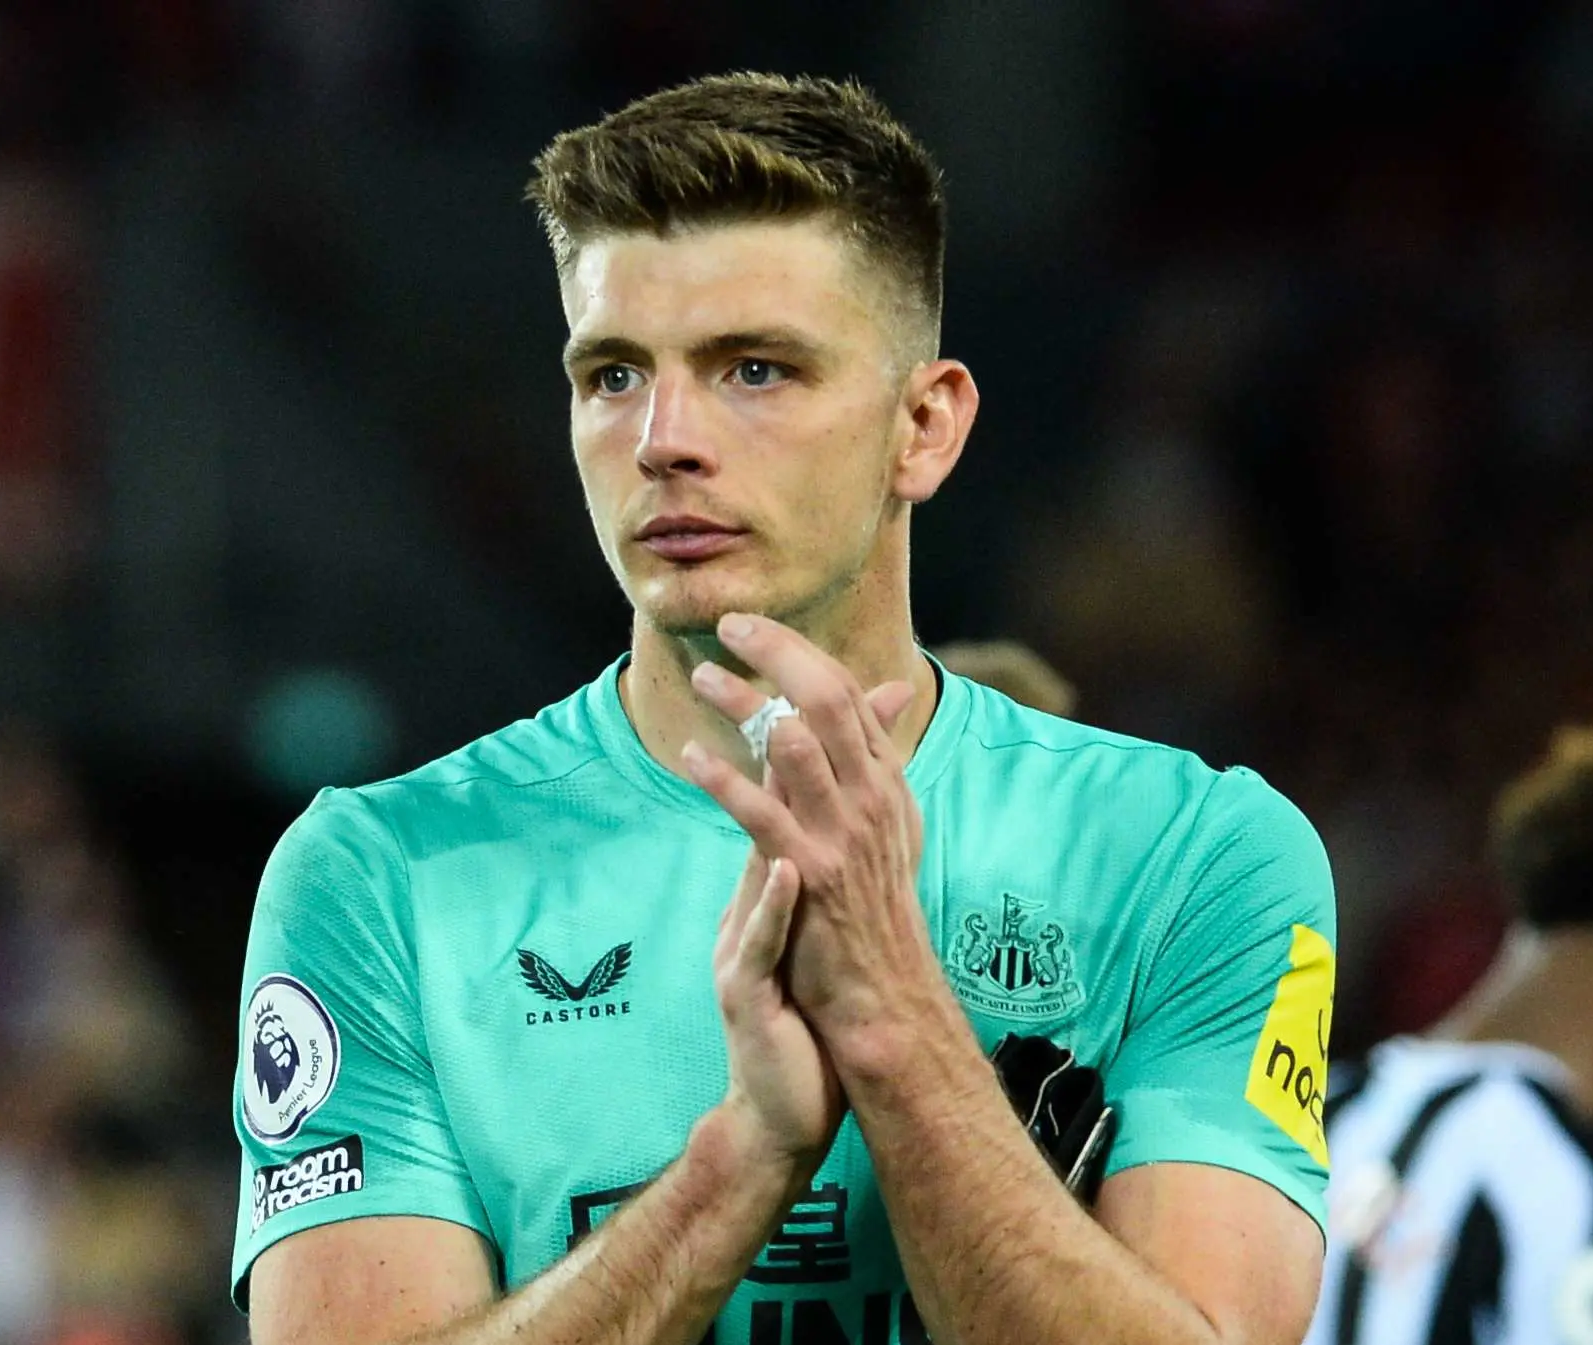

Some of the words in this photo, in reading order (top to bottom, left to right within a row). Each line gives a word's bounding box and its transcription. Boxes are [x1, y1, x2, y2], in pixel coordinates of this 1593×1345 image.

[526, 1001, 631, 1025] CASTORE
[958, 987, 1019, 1012] NEWCASTLE
[1019, 1001, 1061, 1014] UNITED
[278, 1088, 307, 1124] Pemier
[303, 1039, 322, 1088] League
[270, 1147, 349, 1190] room
[267, 1168, 363, 1216] racism
